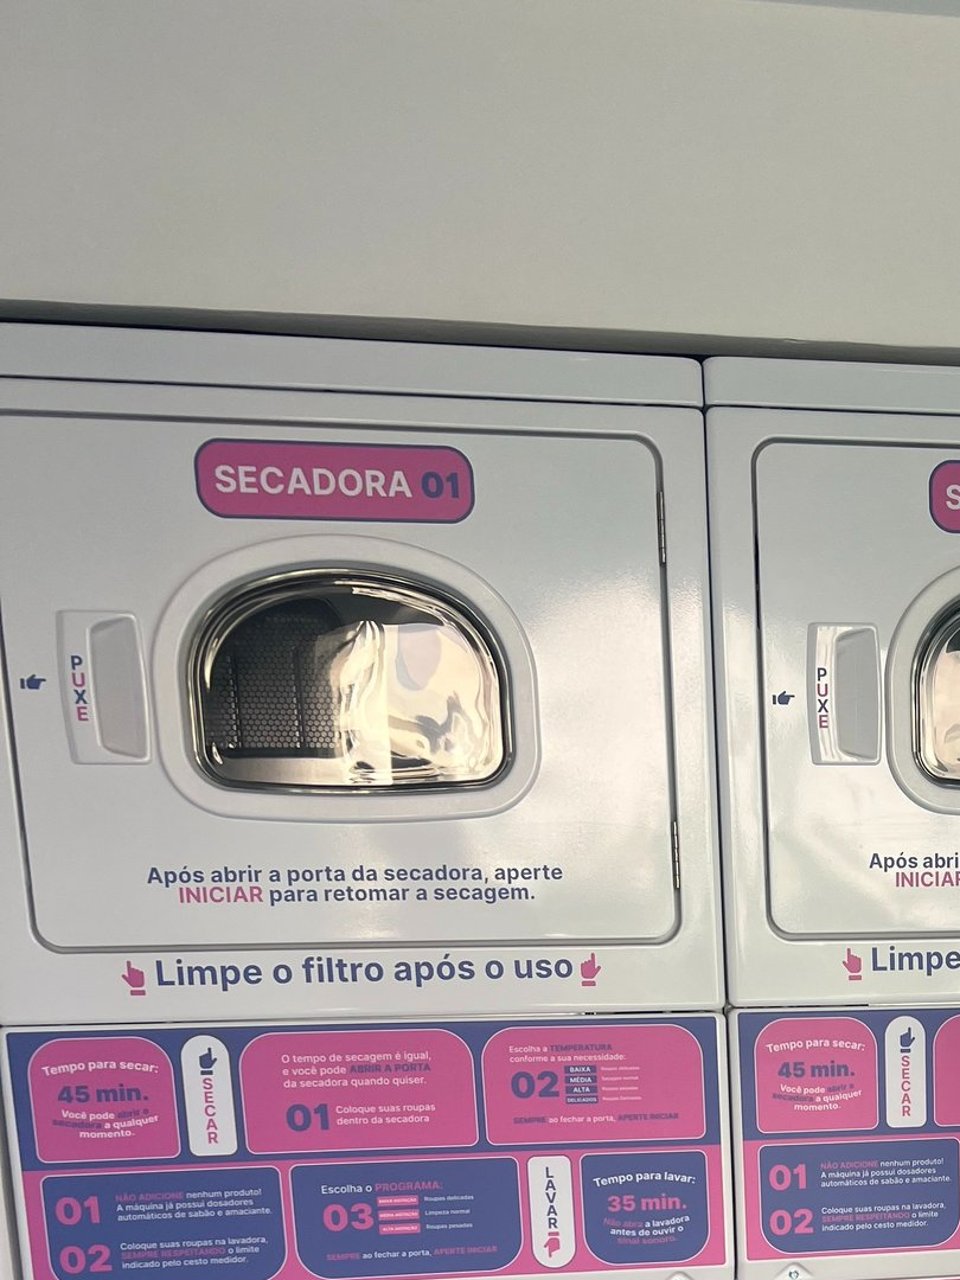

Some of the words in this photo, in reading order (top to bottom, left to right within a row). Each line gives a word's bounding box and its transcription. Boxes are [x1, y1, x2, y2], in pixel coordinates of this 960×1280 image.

[215, 465, 412, 497] SECADORA
[422, 472, 459, 498] 01
[71, 655, 88, 721] PUXE
[817, 667, 829, 729] PUXE
[870, 852, 917, 872] Após
[148, 866, 204, 888] Após
[211, 865, 262, 883] abrir
[268, 869, 281, 883] a
[288, 867, 345, 886] porta
[352, 865, 377, 881] da
[384, 865, 488, 884] secadora,
[495, 865, 562, 884] aperte
[179, 886, 263, 903] INICIAR
[270, 890, 317, 906] para
[324, 885, 410, 902] retomar
[415, 887, 428, 901] a
[434, 888, 534, 904] secagem.
[156, 959, 262, 991] Limpe
[273, 965, 292, 983] o
[302, 957, 383, 983] filtro
[395, 961, 475, 987] após
[485, 960, 504, 979] o
[514, 959, 572, 978] uso
[872, 946, 960, 976] Limpe
[40, 1062, 86, 1077] Tempo
[87, 1060, 117, 1072] para
[119, 1061, 159, 1074] secar:
[778, 1062, 805, 1078] 45
[811, 1060, 855, 1077] min.
[58, 1086, 90, 1103] 45
[96, 1083, 148, 1102] min.
[900, 1055, 912, 1117] SECAR
[202, 1077, 219, 1145] SECAR
[592, 1173, 634, 1187] Tempo
[635, 1172, 662, 1183] para
[663, 1171, 696, 1184] lavar:
[544, 1166, 558, 1230] LAVAR
[608, 1195, 635, 1212] 35
[641, 1193, 686, 1210] min.
